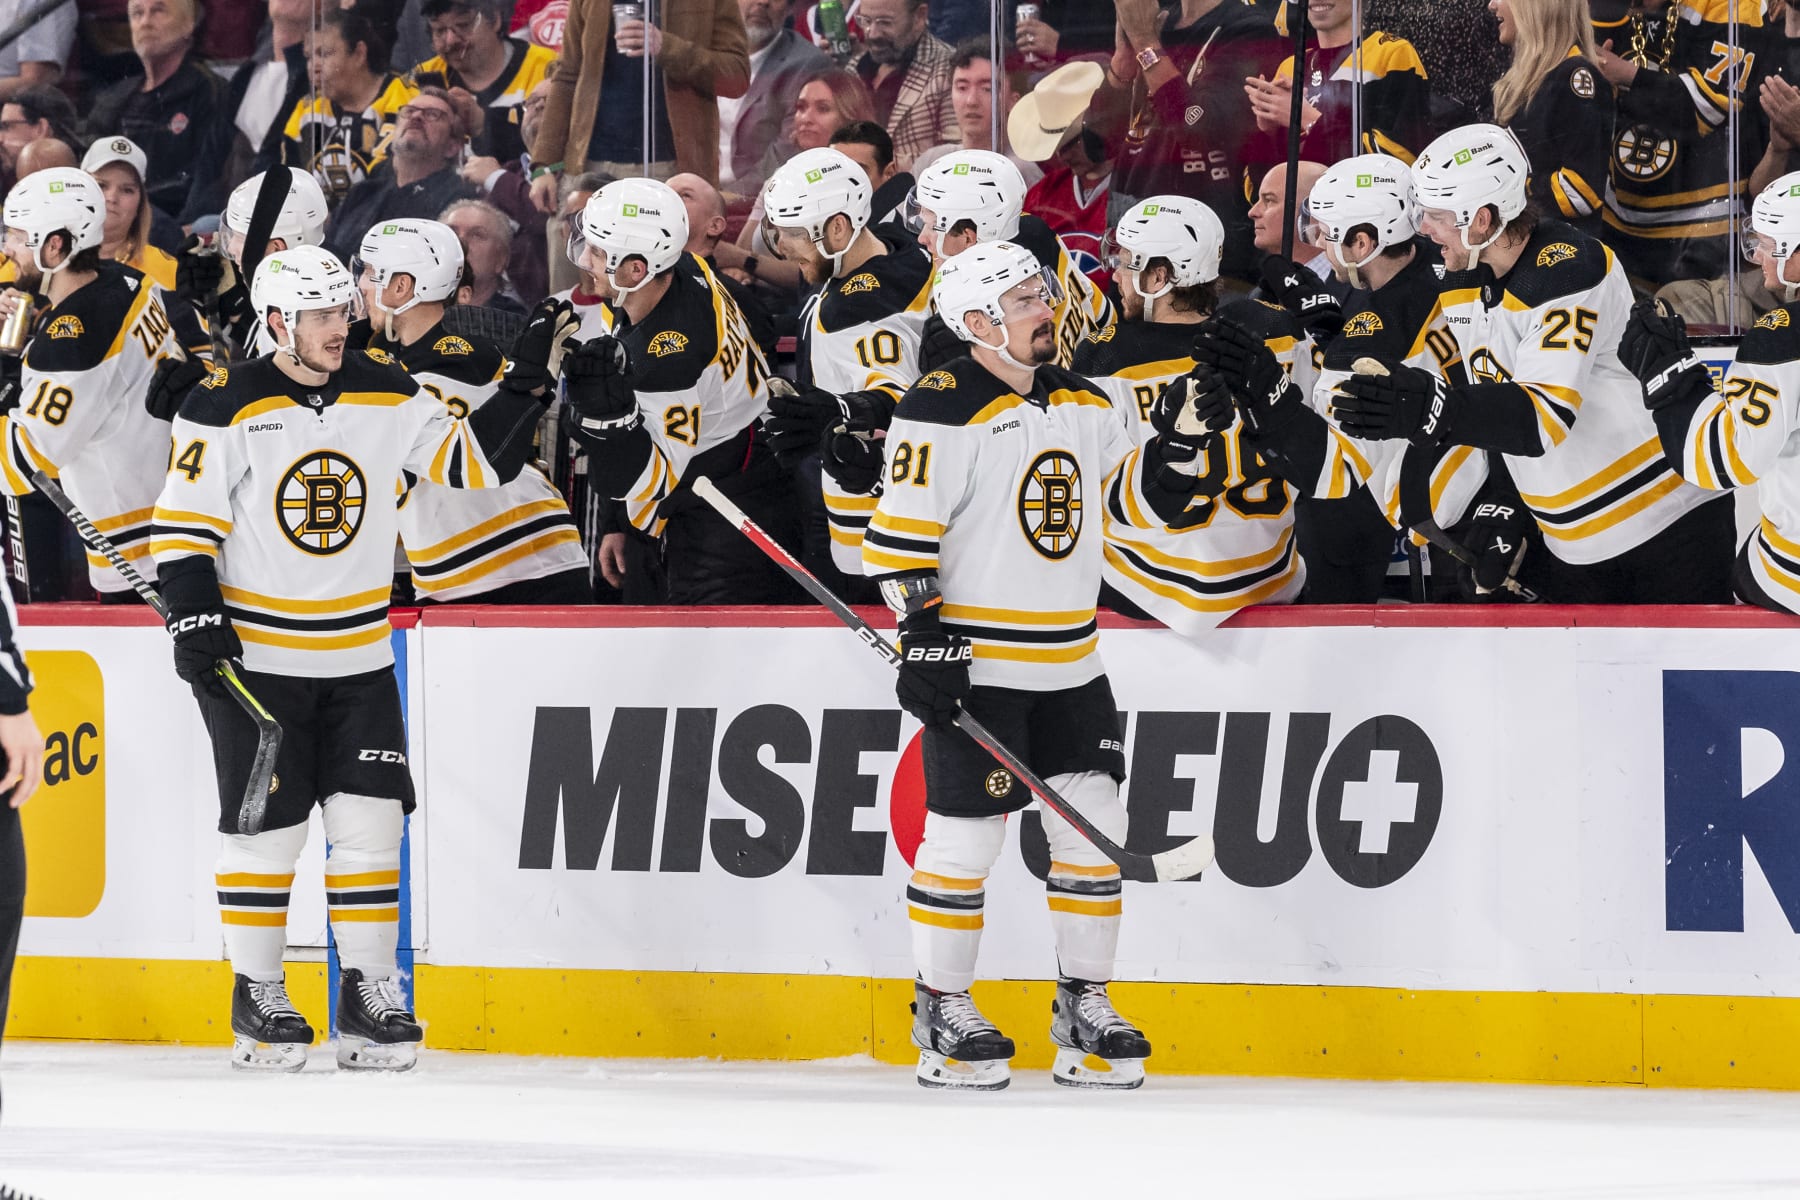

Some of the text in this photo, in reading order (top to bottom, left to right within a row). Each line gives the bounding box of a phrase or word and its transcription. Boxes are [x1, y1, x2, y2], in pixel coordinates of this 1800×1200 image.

[821, 163, 842, 175] Bank
[1471, 143, 1494, 155] Bank
[970, 167, 993, 175] Bank
[398, 227, 419, 235] Bank
[639, 208, 661, 216] Bank
[1160, 207, 1182, 215] Bank
[281, 265, 300, 274] Bank
[853, 329, 902, 369] 10
[1540, 305, 1600, 355] 25
[26, 378, 75, 427] 18
[663, 404, 702, 447] 21
[168, 436, 209, 484] 4
[891, 440, 933, 487] 81
[518, 703, 902, 879] MISE
[1663, 669, 1800, 934] R
